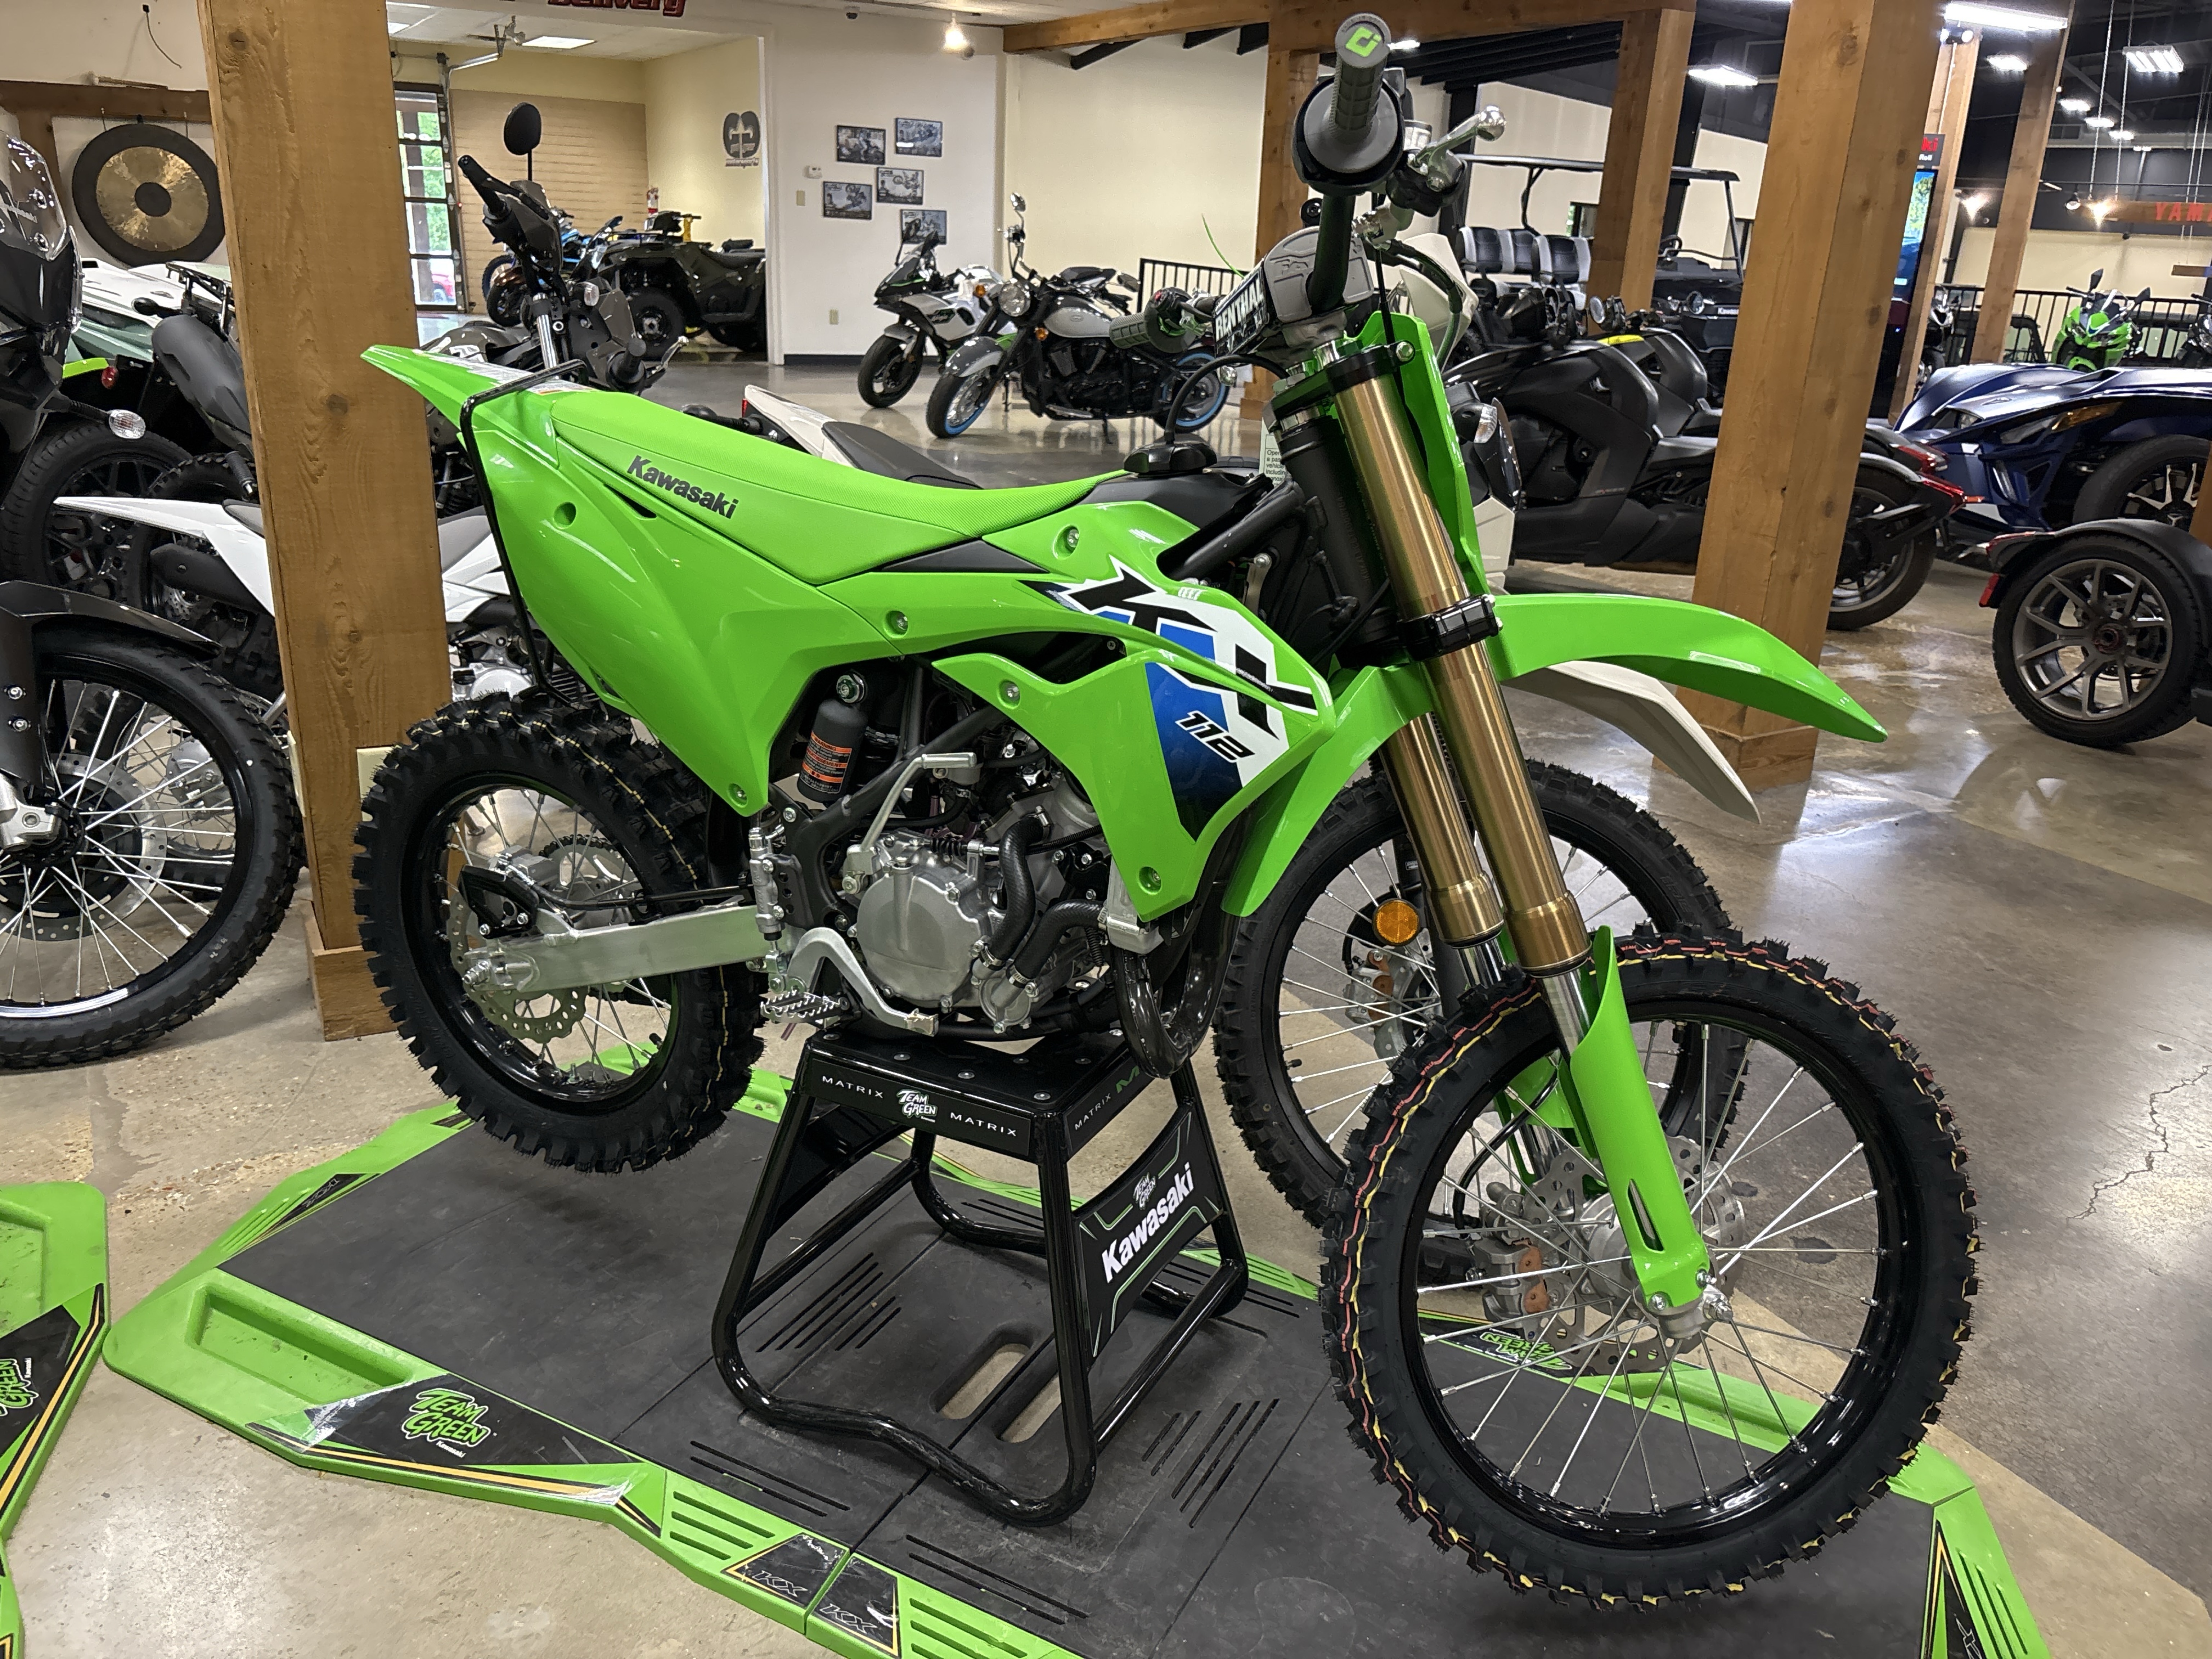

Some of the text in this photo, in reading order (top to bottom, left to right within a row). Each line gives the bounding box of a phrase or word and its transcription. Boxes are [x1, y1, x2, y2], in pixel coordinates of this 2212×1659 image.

[1215, 277, 1264, 342] RENTHAL
[627, 455, 739, 519] Kawasaki
[1175, 710, 1255, 763] 112
[822, 1075, 883, 1098] MATRIX
[899, 1091, 927, 1103] TEAM
[903, 1102, 936, 1116] GREEN
[1075, 1093, 1111, 1130] MATRIX
[950, 1112, 1016, 1137] MATRIX
[1102, 1161, 1194, 1283] Kawasaki
[413, 1389, 485, 1422] TEAM
[406, 1412, 487, 1443] GREEN
[436, 1440, 466, 1458] Kawasaki
[752, 1570, 808, 1597] KX
[819, 1603, 878, 1633] KX
